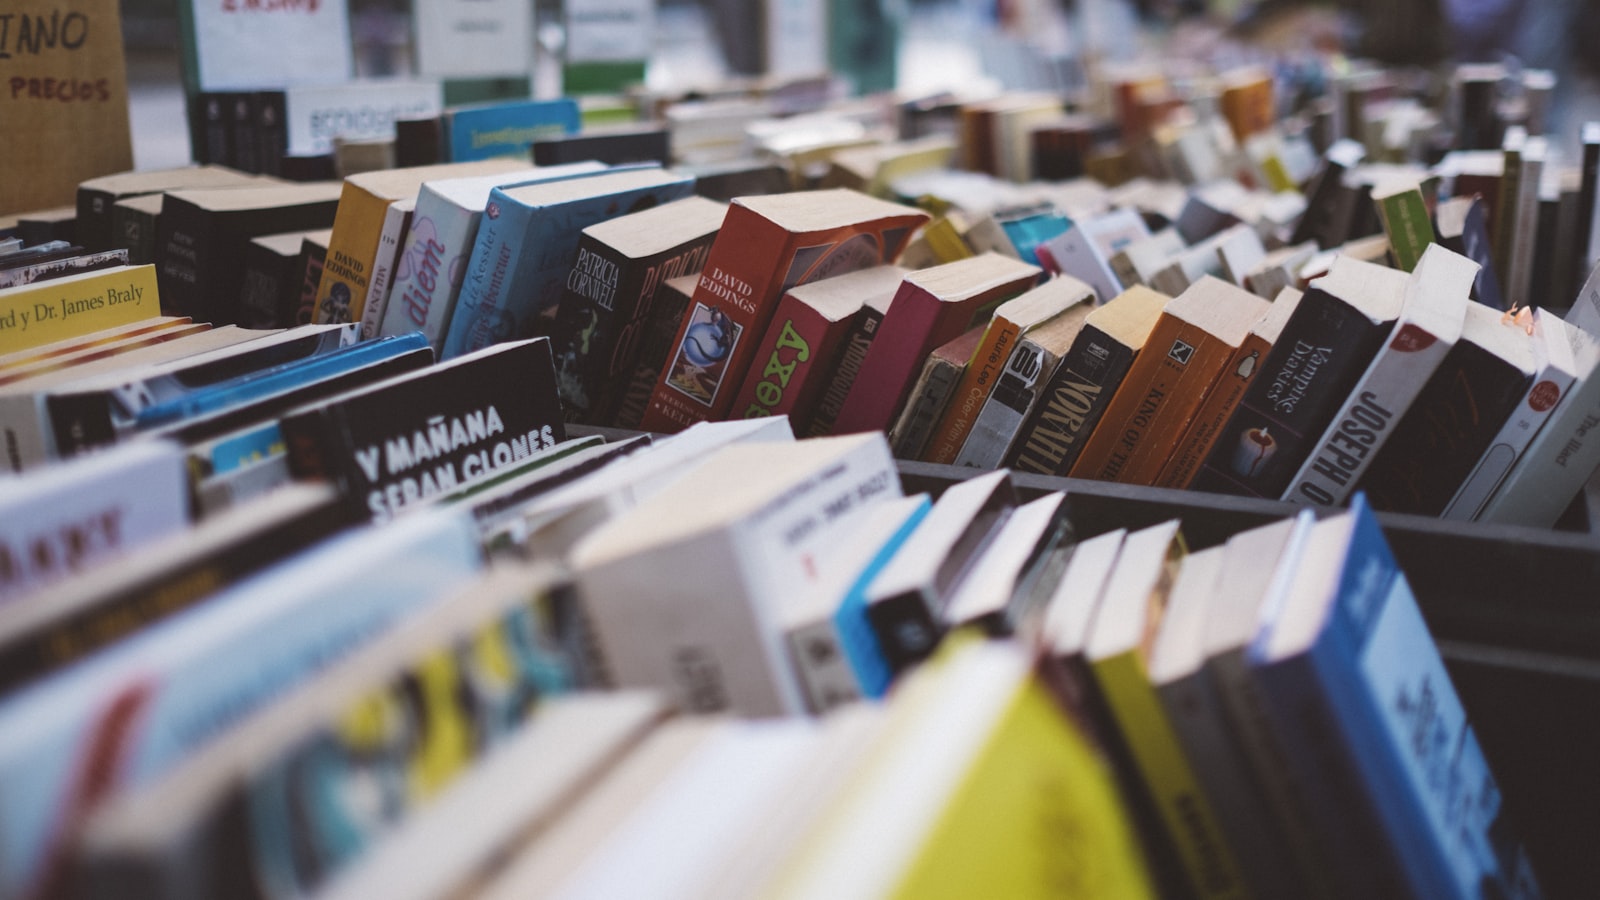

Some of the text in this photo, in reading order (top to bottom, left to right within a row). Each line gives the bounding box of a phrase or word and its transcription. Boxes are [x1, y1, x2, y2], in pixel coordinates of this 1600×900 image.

[10, 77, 111, 102] PRECIOS
[326, 259, 367, 288] EDDINGS
[334, 250, 365, 274] DAVID
[472, 227, 497, 284] Kessler
[575, 247, 620, 289] PATRICIA
[367, 264, 388, 314] MILENA
[402, 238, 446, 327] diem
[567, 269, 616, 312] CORNWELL
[699, 275, 757, 314] EDDINGS
[712, 267, 754, 297] DAVID
[21, 311, 30, 331] y
[34, 303, 58, 322] Dr.
[61, 294, 105, 320] James
[107, 284, 144, 306] Braly
[987, 328, 1014, 367] Laurie
[976, 365, 994, 386] Lee
[1266, 339, 1314, 402] Diaries
[1276, 345, 1333, 414] Vampire
[962, 387, 986, 418] Cider
[1026, 368, 1103, 467] NORAH
[1134, 385, 1165, 427] KING
[355, 404, 505, 483] Y MAÑANA
[461, 424, 555, 483] CLONES
[1120, 427, 1140, 450] OF
[1312, 390, 1393, 488] JOSEPH
[1555, 414, 1599, 468] The Iliad
